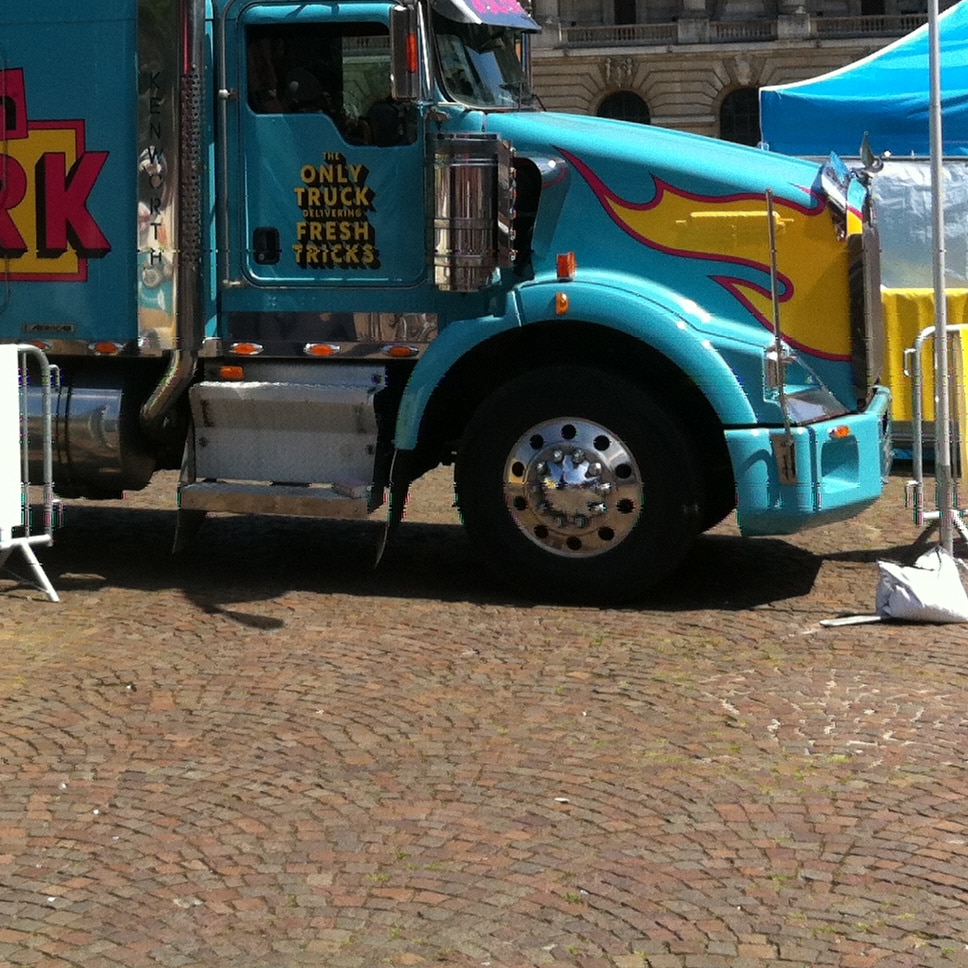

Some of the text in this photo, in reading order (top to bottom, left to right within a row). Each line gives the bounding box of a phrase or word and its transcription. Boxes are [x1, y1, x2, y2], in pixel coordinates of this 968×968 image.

[323, 152, 341, 161] THE
[148, 72, 163, 265] KENWORTH
[300, 164, 364, 184] ONLY
[294, 186, 370, 207] TRUCK
[302, 209, 363, 218] DELIVERING
[296, 221, 370, 241] FRESH
[292, 244, 376, 264] TRICKS
